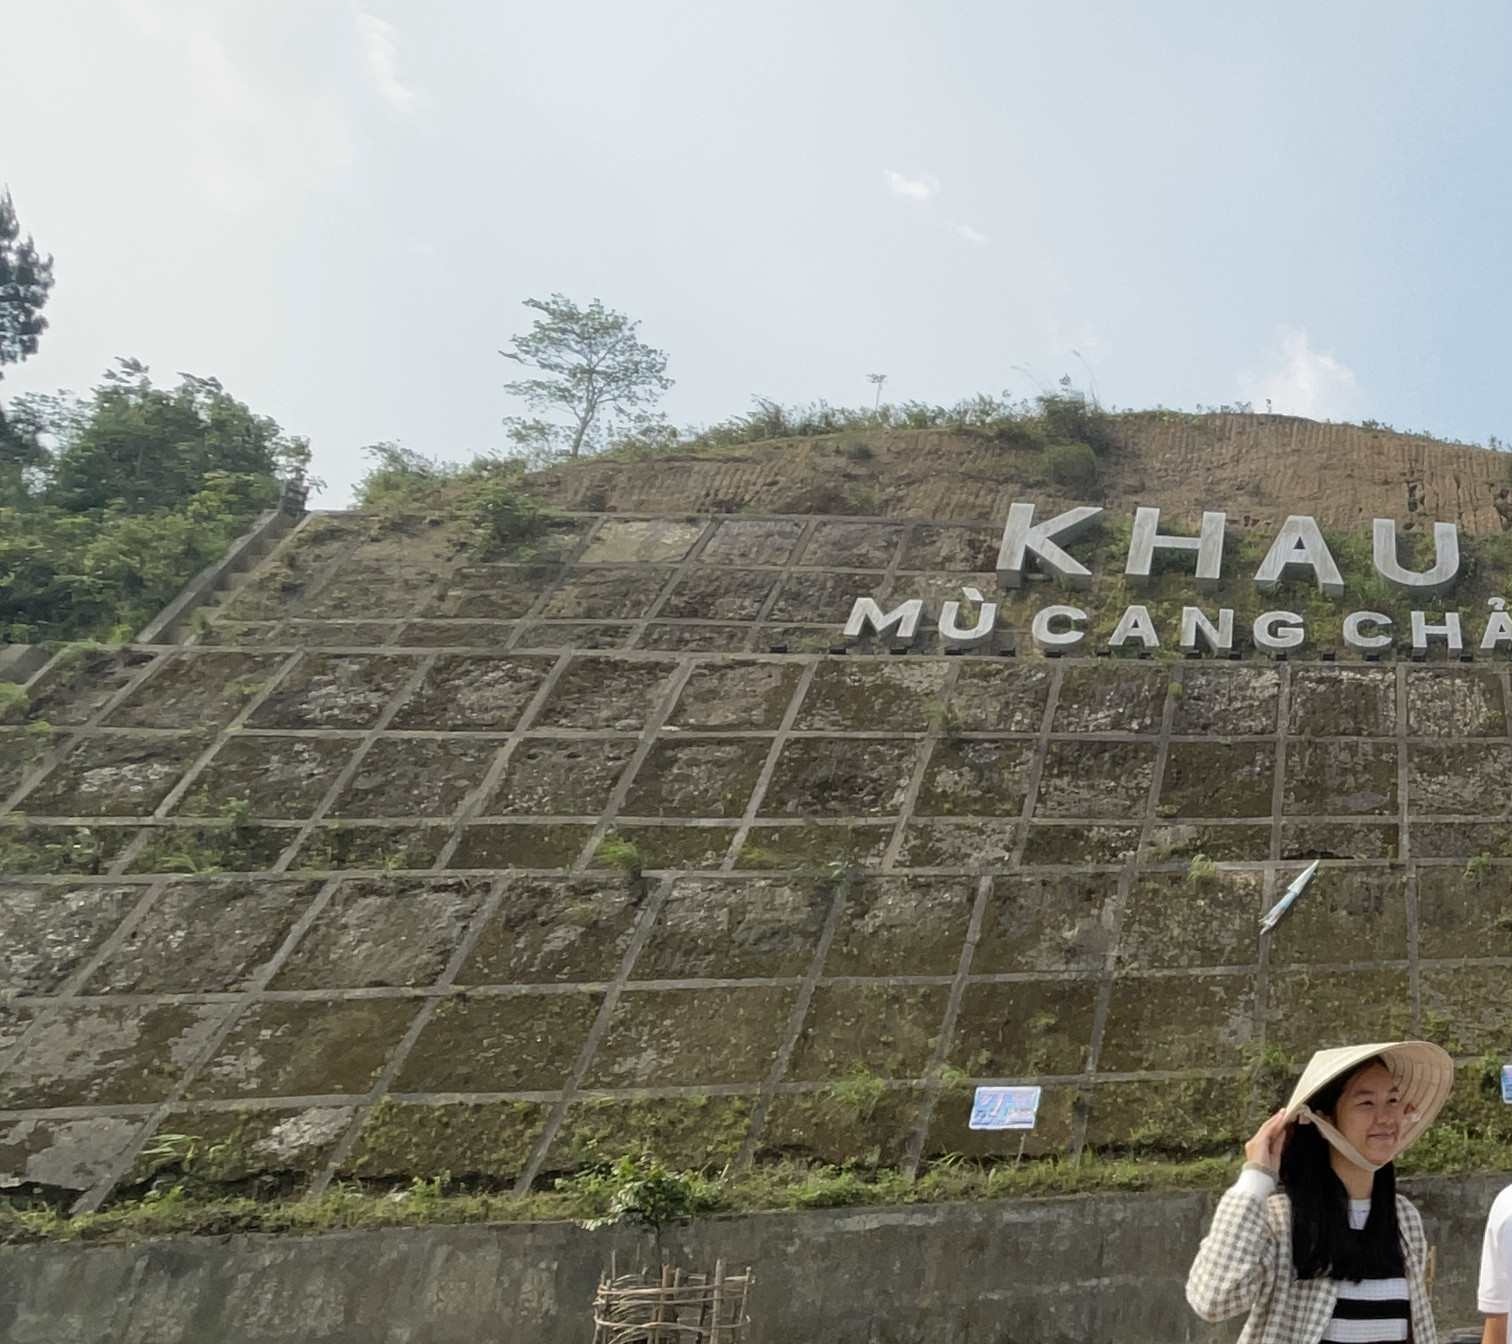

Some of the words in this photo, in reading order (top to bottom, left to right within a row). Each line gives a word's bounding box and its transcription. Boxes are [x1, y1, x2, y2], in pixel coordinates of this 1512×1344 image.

[996, 502, 1461, 594] KHAU
[843, 587, 998, 645] MÙ
[1031, 605, 1305, 649] CANG
